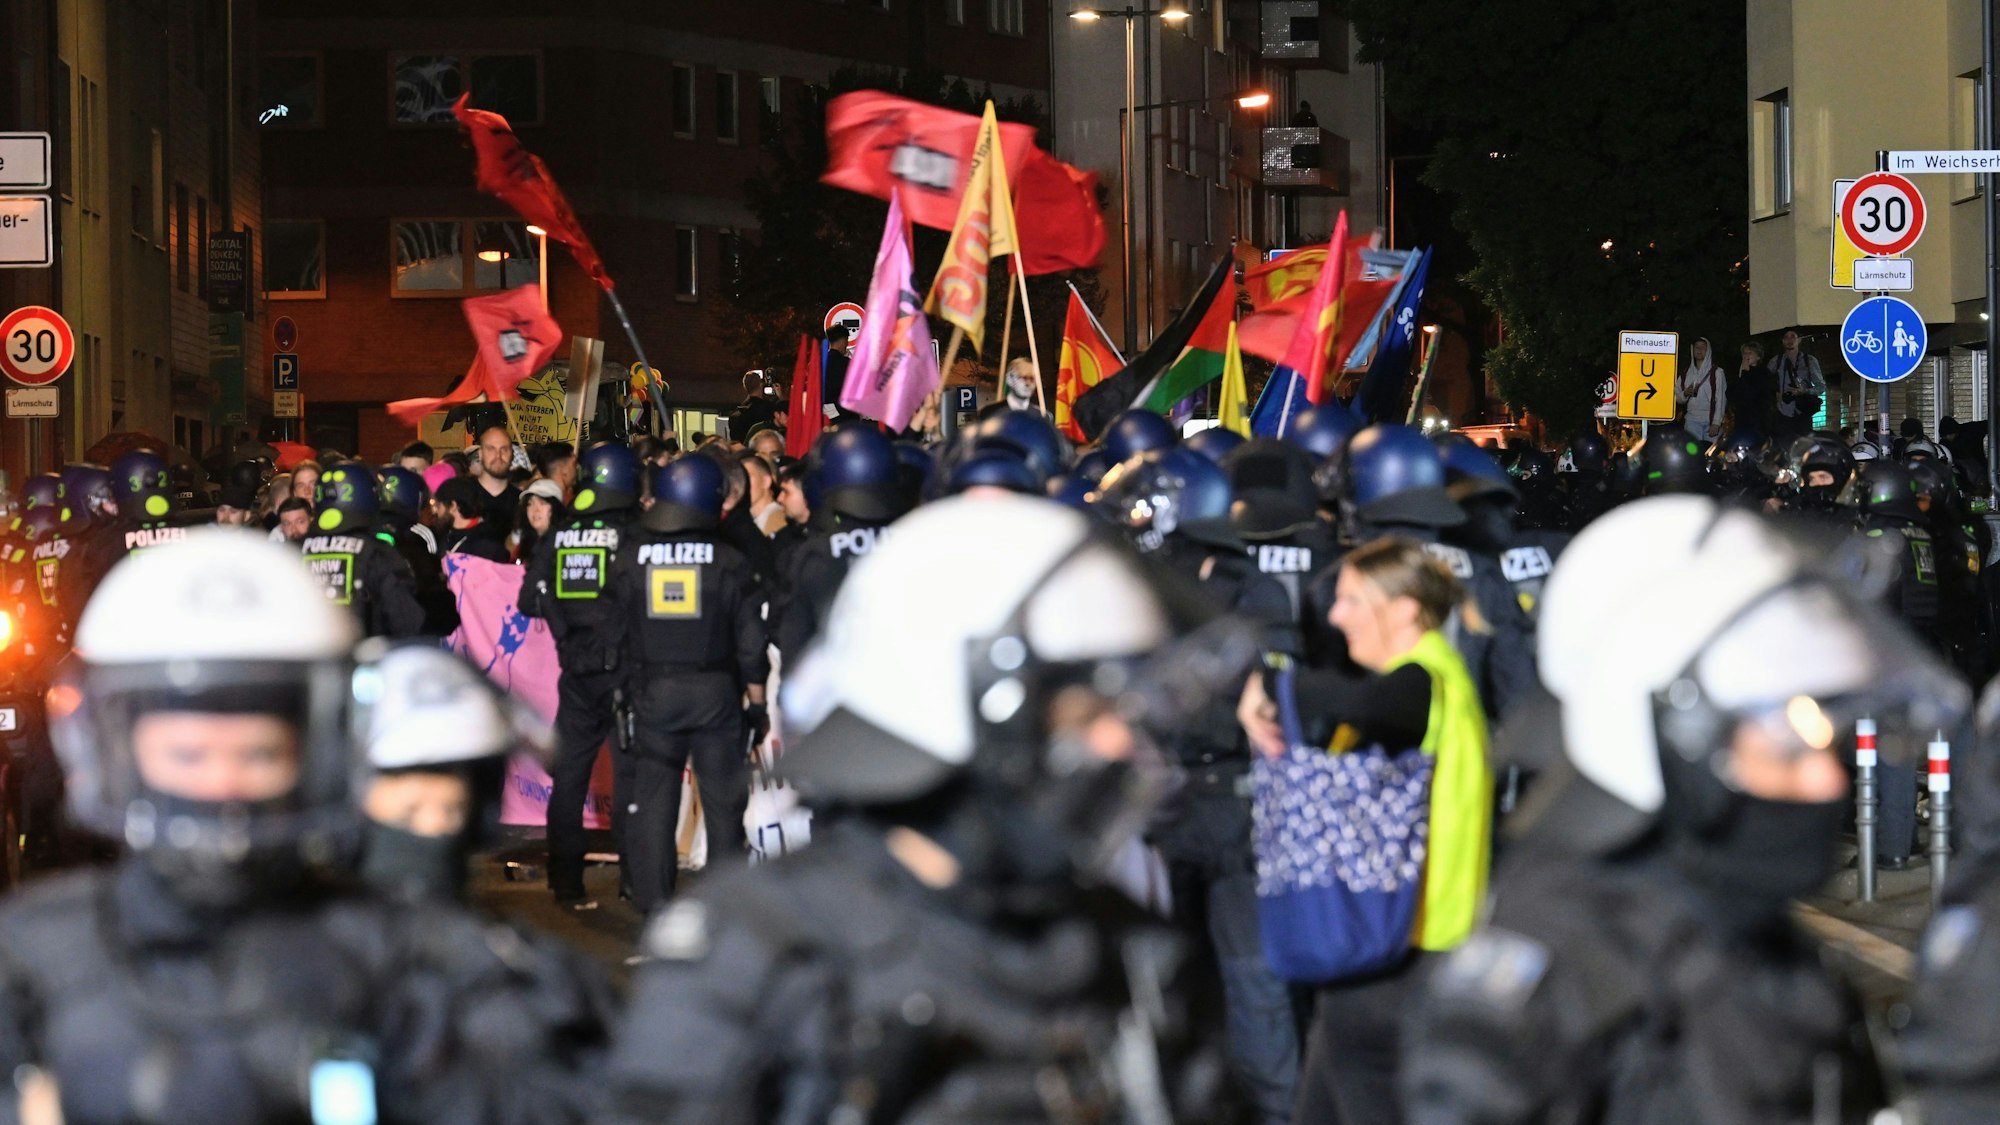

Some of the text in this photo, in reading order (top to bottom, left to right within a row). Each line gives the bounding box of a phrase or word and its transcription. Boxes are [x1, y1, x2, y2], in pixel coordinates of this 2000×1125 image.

[1897, 155, 1915, 168] Im
[0, 214, 29, 228] er-
[1859, 196, 1906, 232] 30
[210, 239, 243, 249] DIGITAL
[210, 261, 242, 271] SOZIAL
[12, 329, 55, 363] 30
[1625, 337, 1673, 347] Rheinaustr.
[279, 358, 293, 386] P
[1641, 358, 1655, 377] U
[12, 400, 53, 408] Lärmschutz
[960, 388, 973, 408] P
[526, 405, 554, 415] STERBEN
[128, 471, 168, 492] 3 2
[341, 483, 354, 502] 2
[302, 536, 364, 554] POLIZEI
[637, 543, 714, 565] POLIZEI
[311, 560, 341, 574] NRW
[565, 554, 595, 567] NRW
[1247, 544, 1312, 573] IZEI
